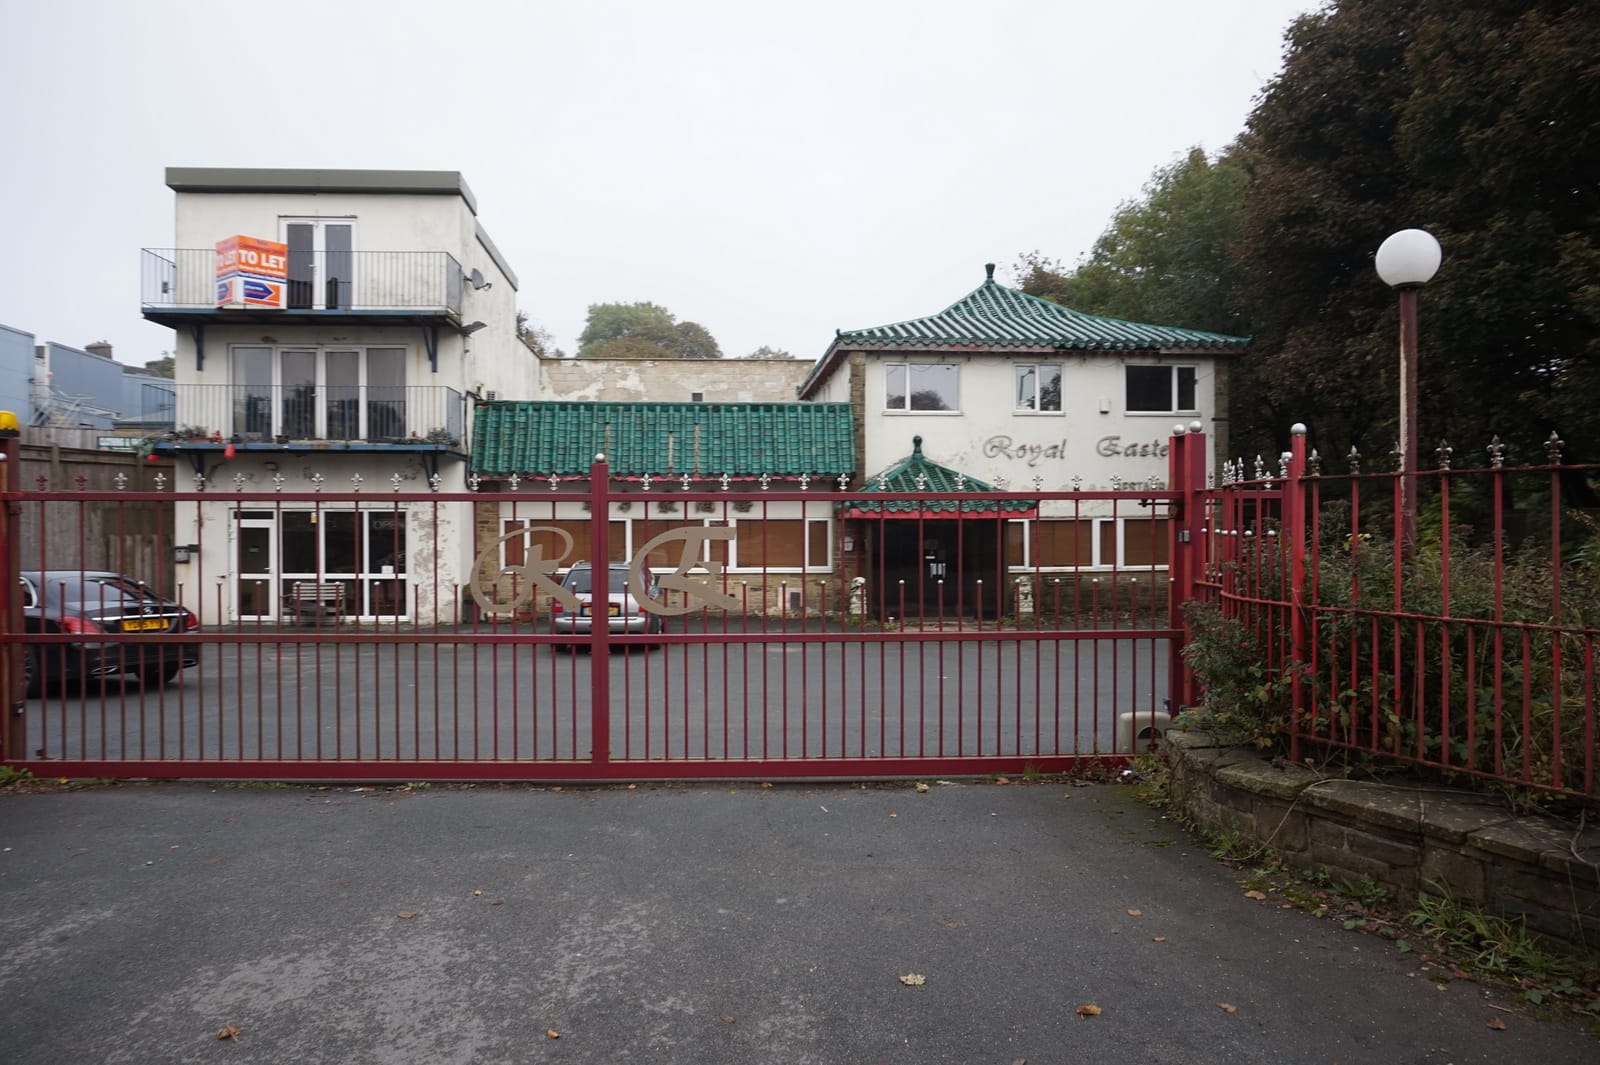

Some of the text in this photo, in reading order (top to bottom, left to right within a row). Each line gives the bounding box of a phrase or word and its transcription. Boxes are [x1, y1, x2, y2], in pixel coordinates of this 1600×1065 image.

[238, 249, 258, 265] TO
[261, 253, 286, 269] LET
[983, 435, 1169, 467] Royal Easte
